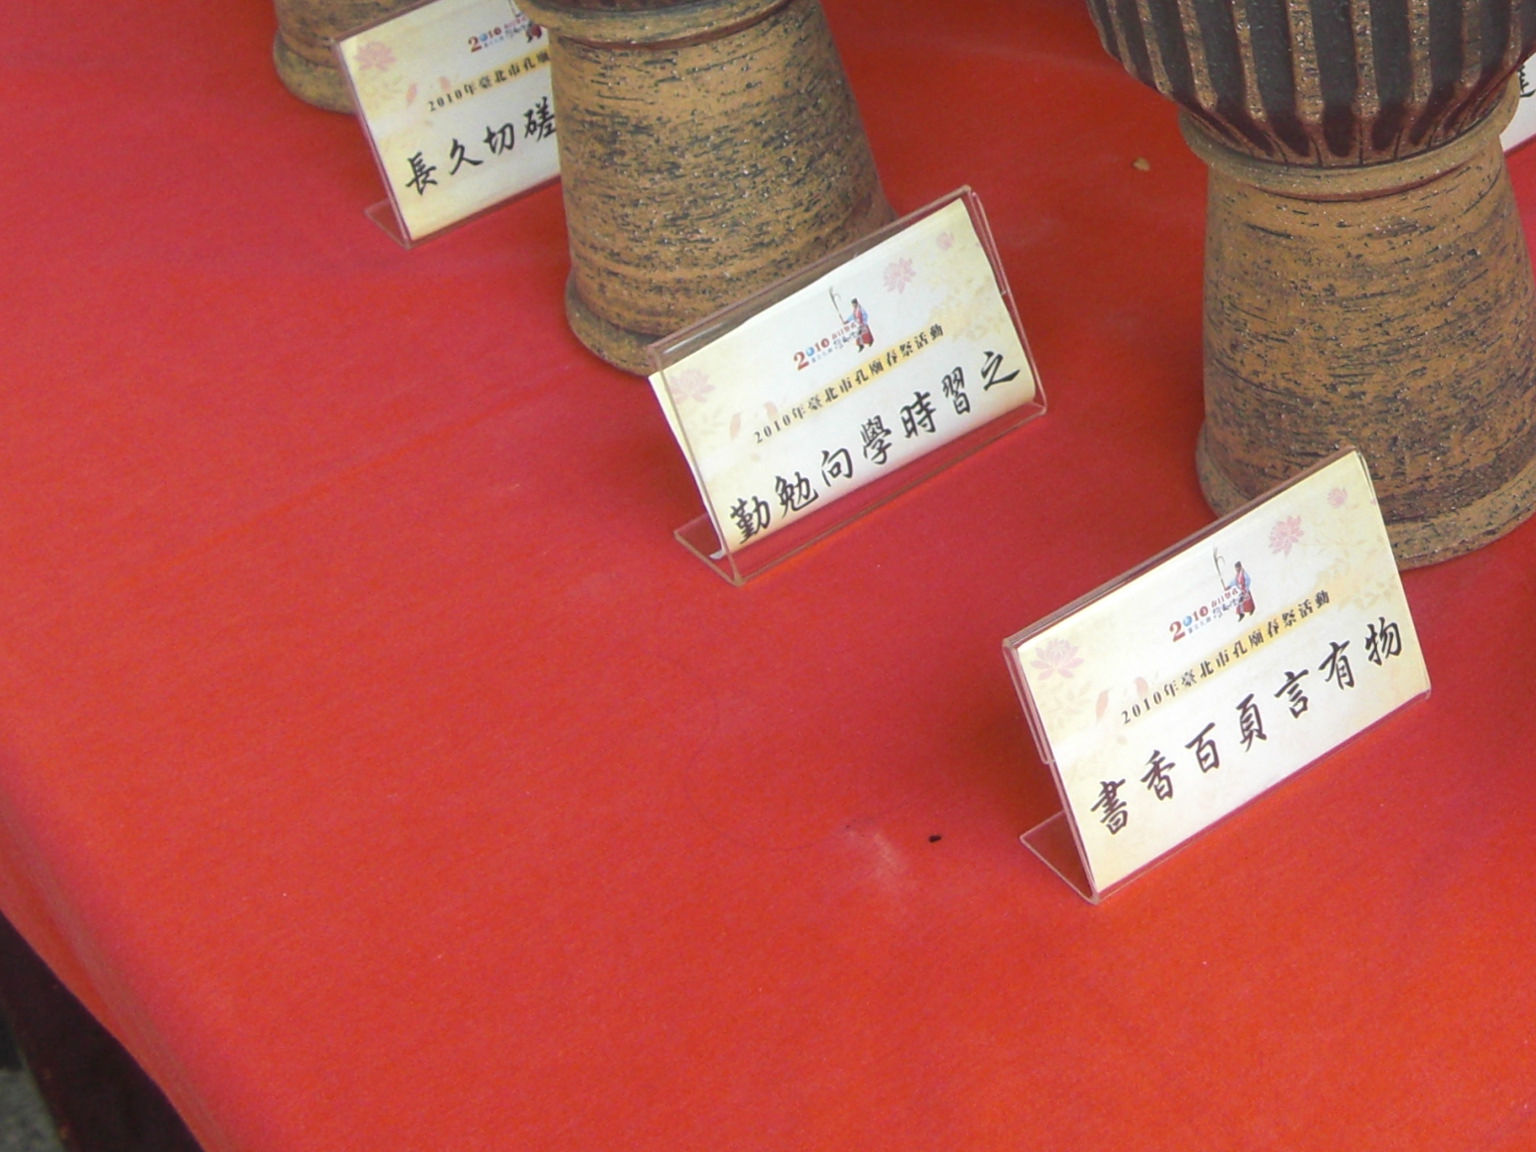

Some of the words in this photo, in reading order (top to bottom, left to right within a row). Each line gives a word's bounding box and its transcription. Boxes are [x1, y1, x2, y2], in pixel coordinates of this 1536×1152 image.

[406, 96, 556, 196] 長久切磋
[730, 351, 1020, 545] 勤勉向學時習之
[754, 323, 944, 444] 2010年臺北市孔廟春祭活動
[1121, 590, 1330, 725] 2010年臺北市孔廟春祭活動
[1091, 617, 1403, 836] 書香百頁言有物
